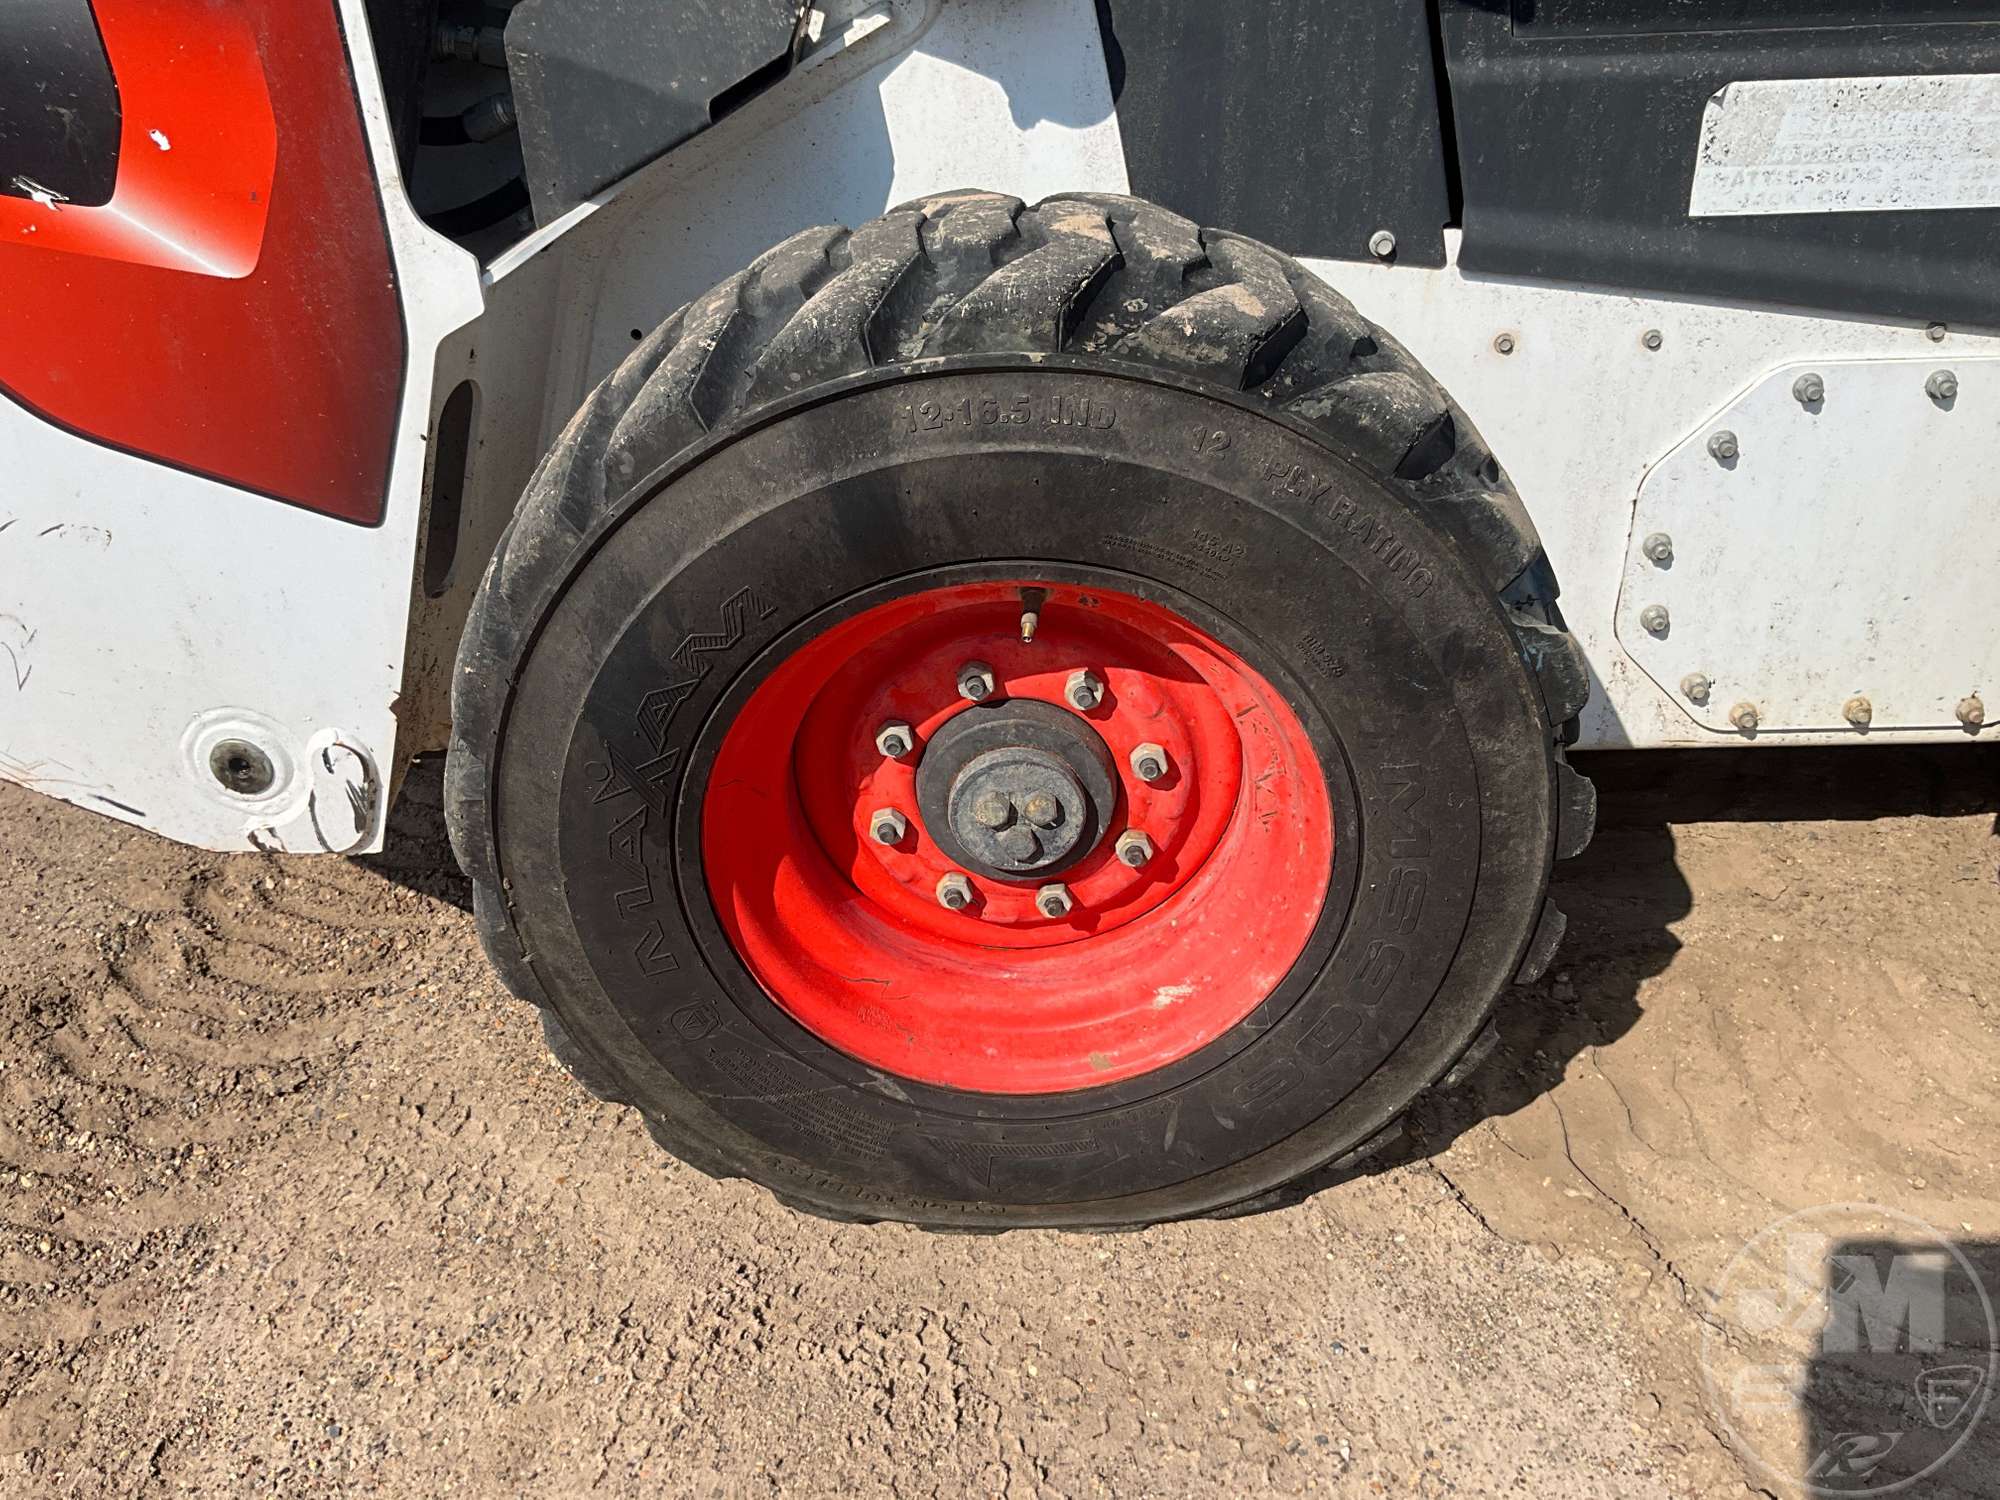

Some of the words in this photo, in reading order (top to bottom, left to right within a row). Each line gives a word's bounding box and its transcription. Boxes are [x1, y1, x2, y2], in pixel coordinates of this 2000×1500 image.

[901, 393, 1031, 432] 12-16.5
[1049, 394, 1117, 429] IND
[1192, 425, 1232, 459] 12
[1262, 460, 1332, 507] PLY
[1328, 494, 1439, 599] RATING
